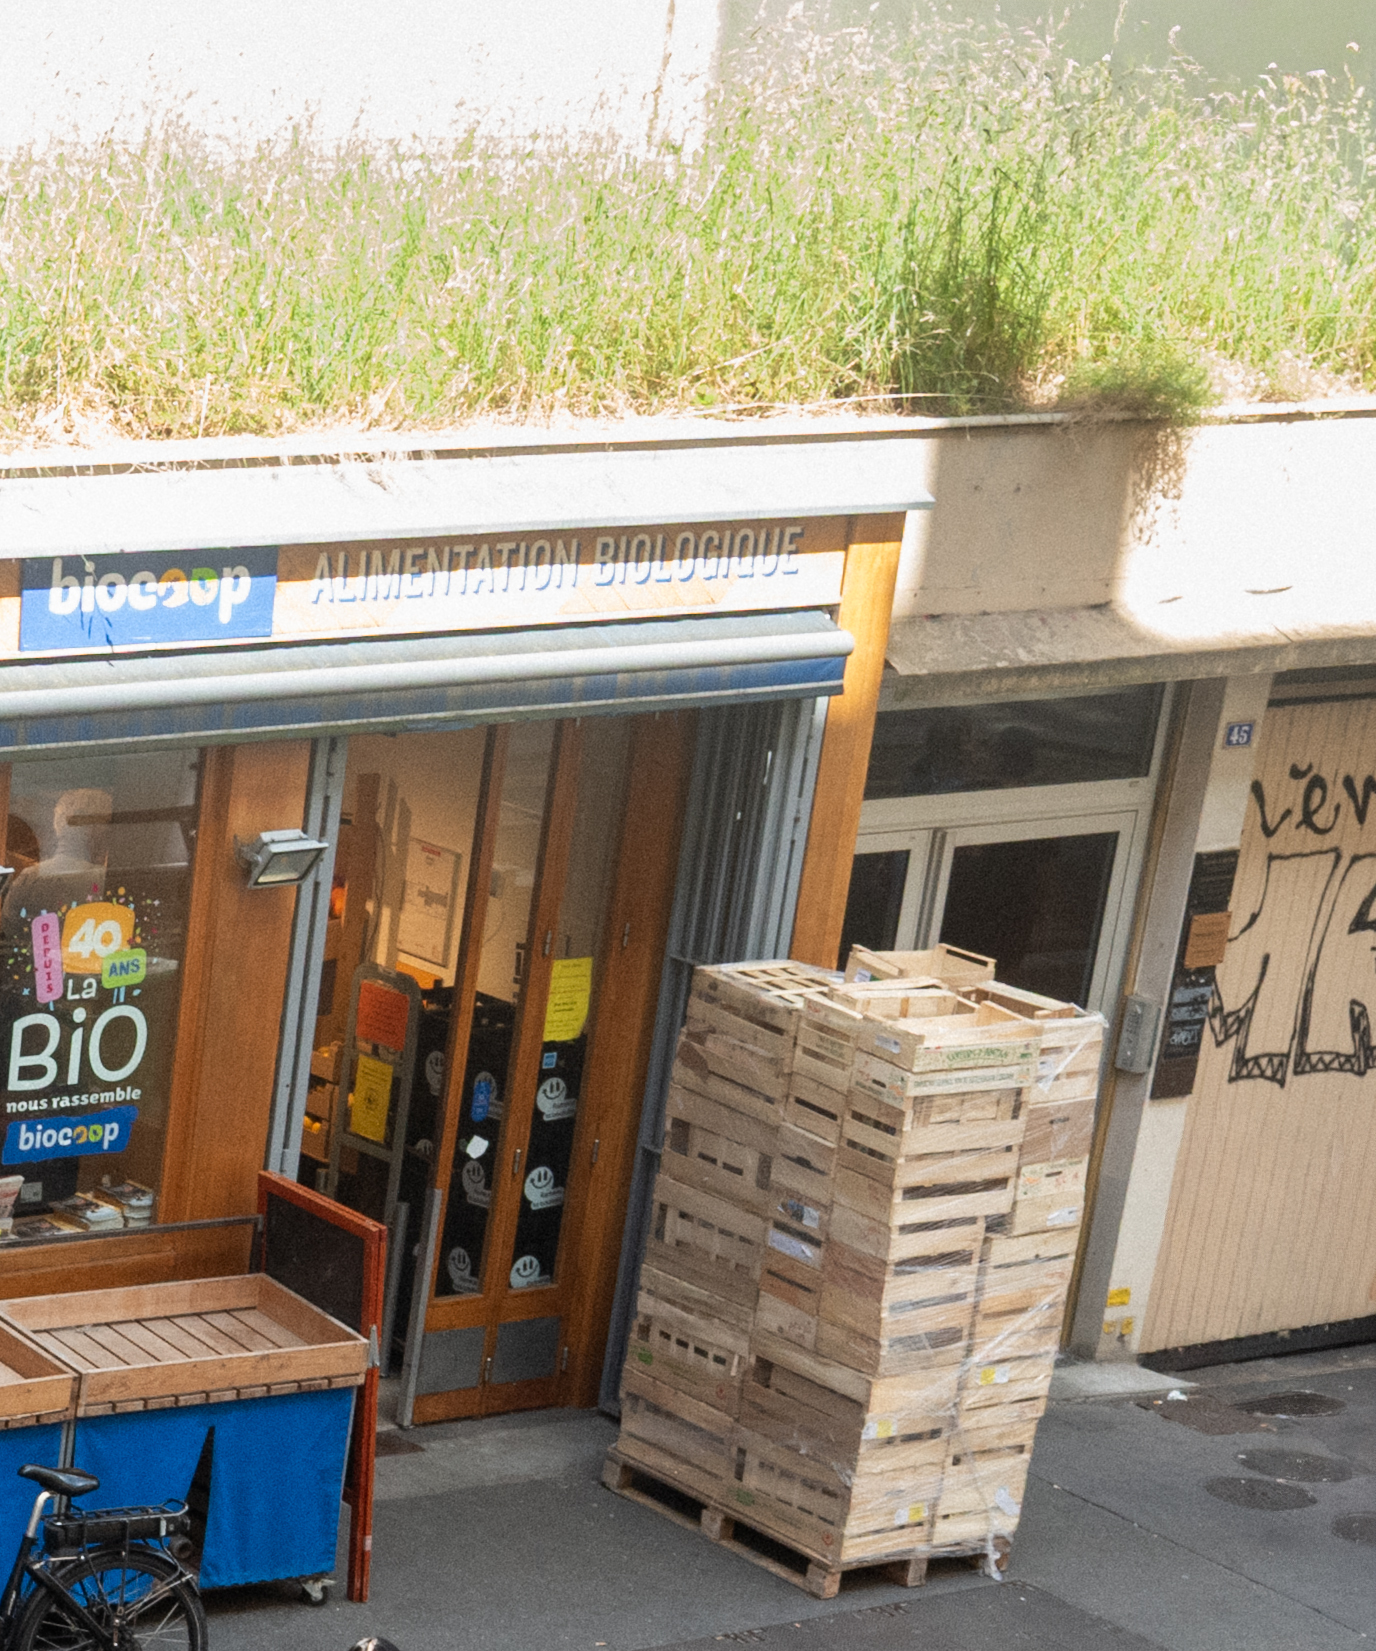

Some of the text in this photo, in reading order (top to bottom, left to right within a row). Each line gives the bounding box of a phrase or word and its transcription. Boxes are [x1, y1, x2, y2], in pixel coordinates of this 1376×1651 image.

[311, 525, 806, 604] ALIMENTATION BIOLOGIQUE
[48, 557, 252, 624] biocoop
[41, 922, 54, 994] DEPUIS
[68, 918, 123, 959] 40
[108, 958, 141, 978] ANS
[67, 978, 97, 1001] La
[7, 1004, 148, 1092] BiO
[6, 1086, 142, 1114] nous rassemble
[18, 1122, 120, 1151] biocoop
